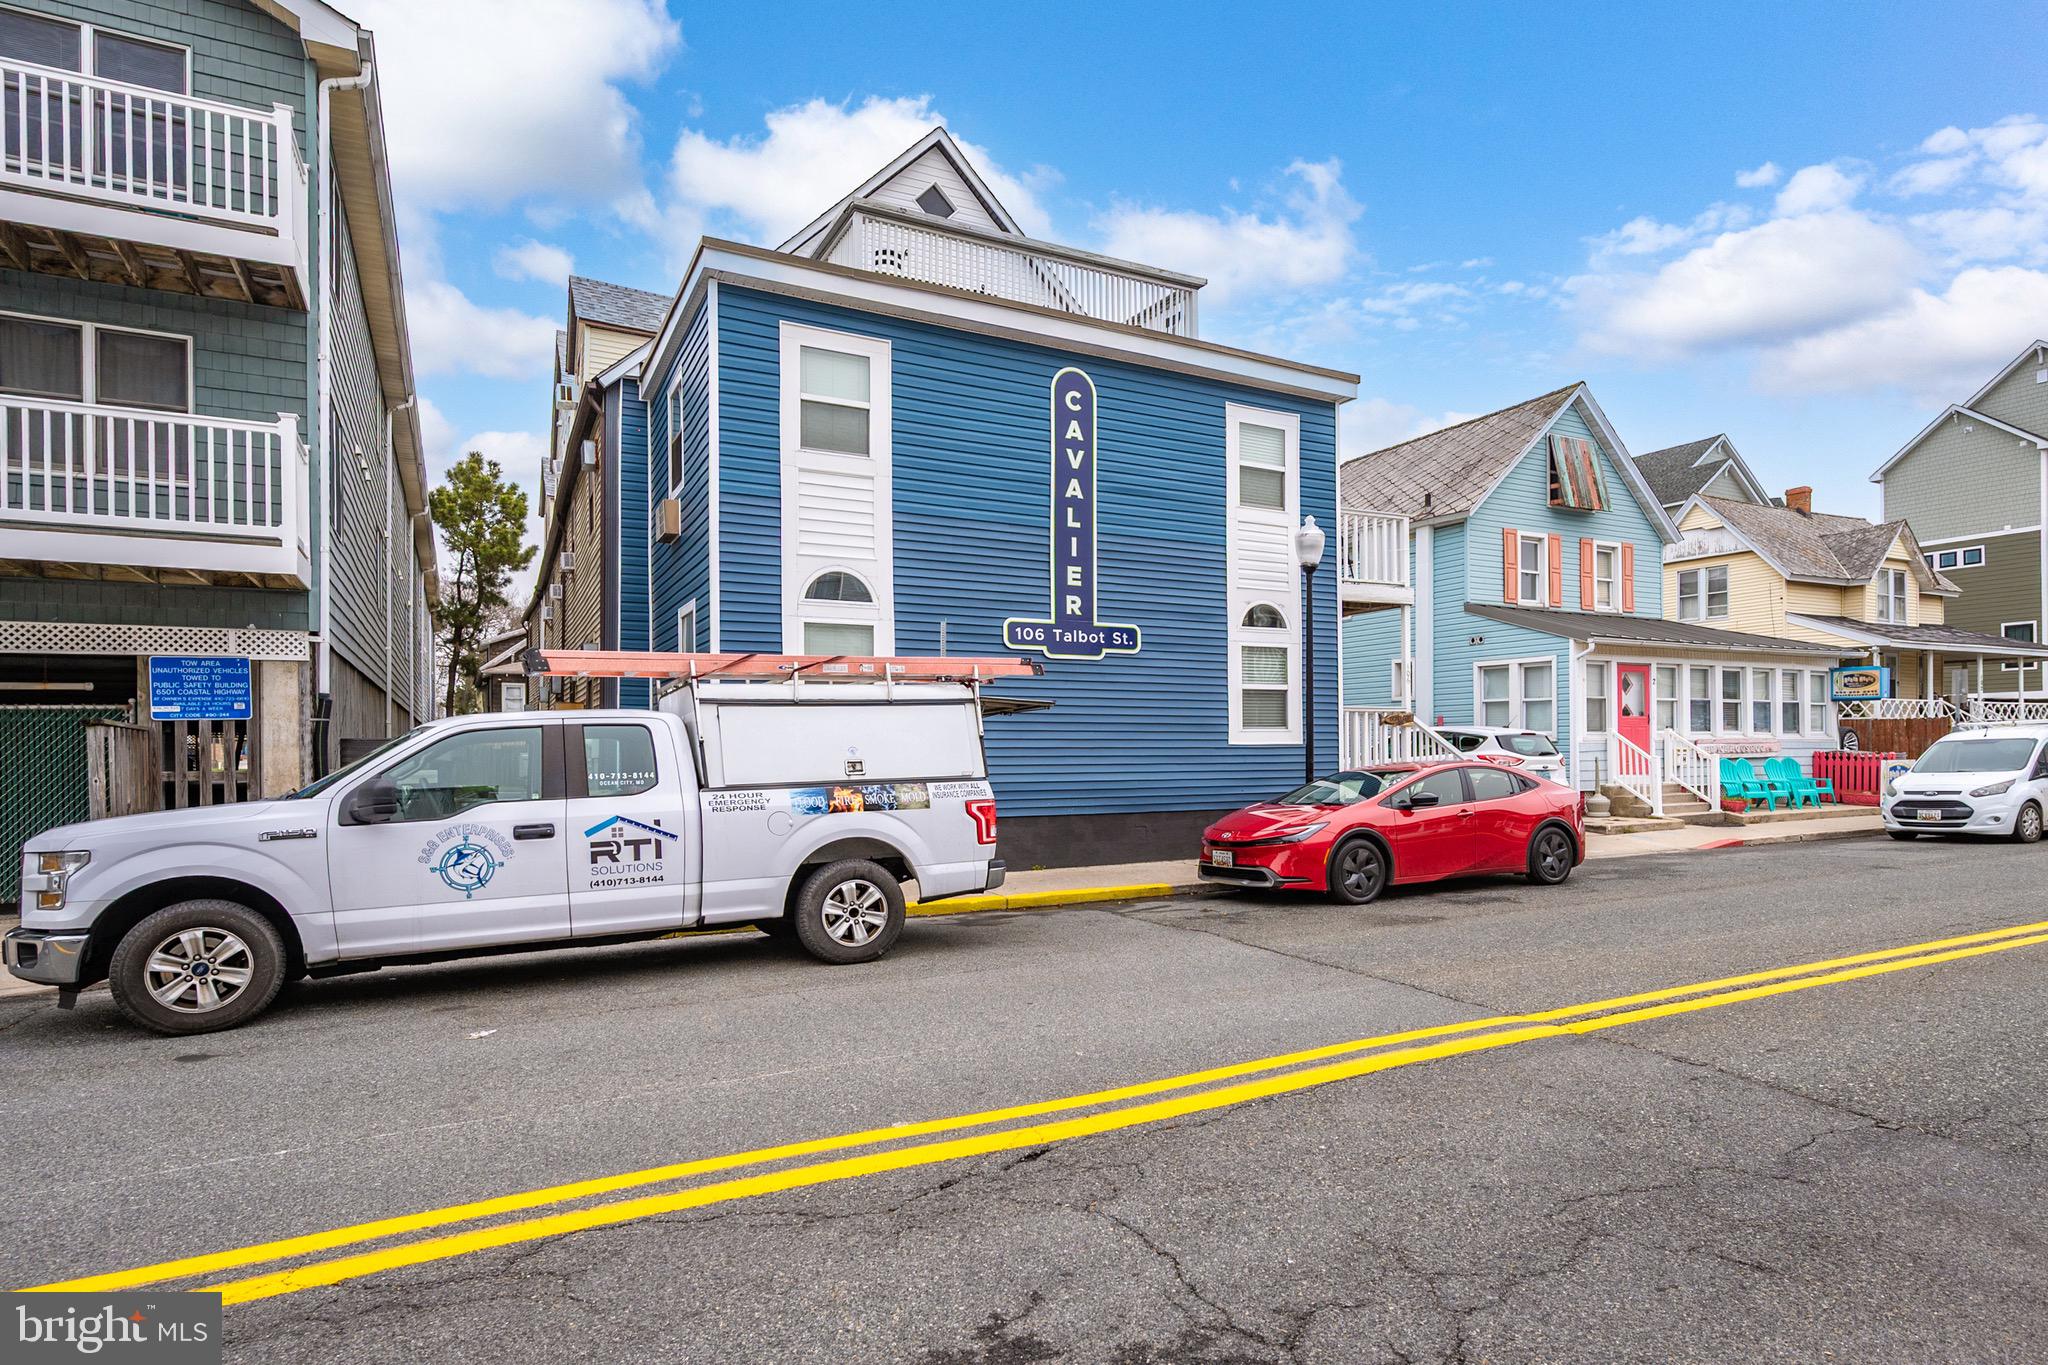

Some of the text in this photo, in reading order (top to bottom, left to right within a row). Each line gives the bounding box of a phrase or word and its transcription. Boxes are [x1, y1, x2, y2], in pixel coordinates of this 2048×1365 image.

[1065, 390, 1085, 616] CAVALIER
[1015, 627, 1133, 645] 106 Talbot St.
[588, 772, 655, 780] 410-713-8144
[864, 793, 896, 805] SMOKE
[901, 791, 926, 801] MOLD
[932, 788, 987, 799] INSURANCE COMPANIES
[708, 798, 771, 806] EMERGENCY
[835, 795, 857, 806] FIRE
[436, 823, 515, 858] ENTERPRISES
[590, 833, 663, 864] RTI
[591, 862, 663, 876] SOLUTIONS
[590, 875, 664, 889] (410)713-8144
